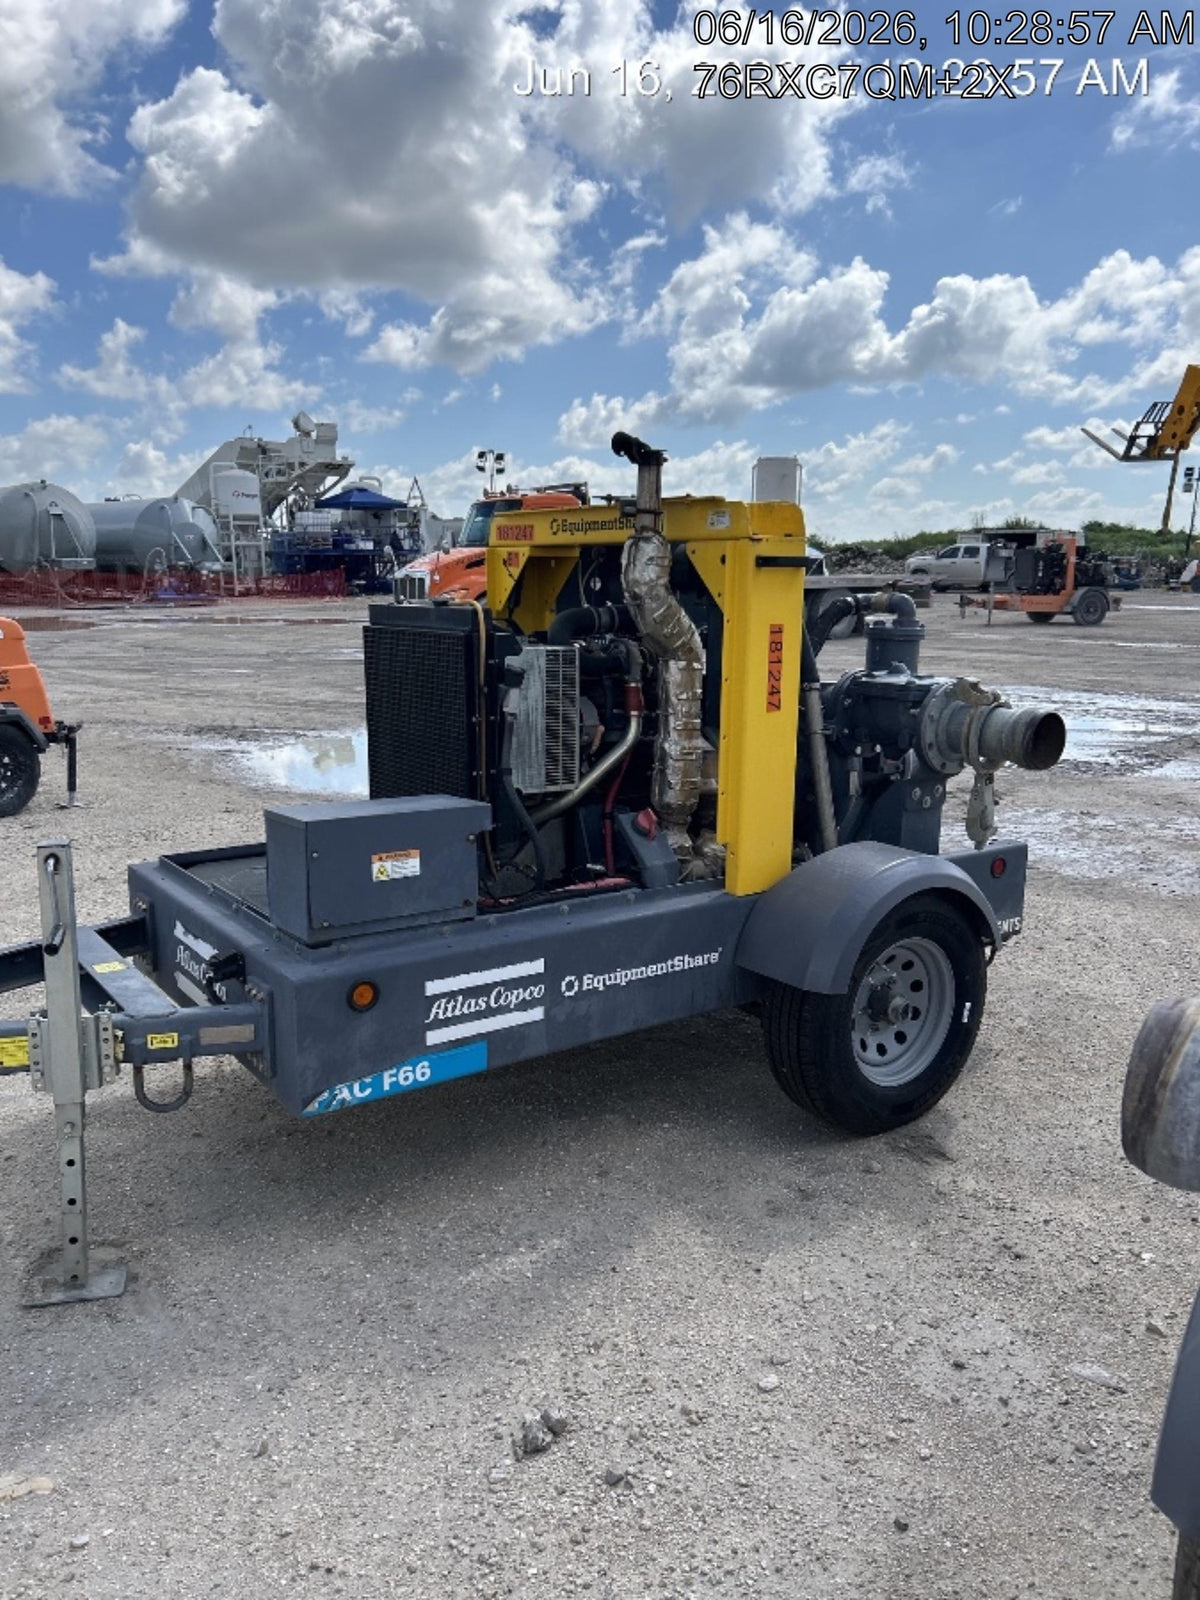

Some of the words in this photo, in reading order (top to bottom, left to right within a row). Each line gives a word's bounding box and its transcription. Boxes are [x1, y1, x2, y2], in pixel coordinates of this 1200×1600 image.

[497, 525, 534, 541] 181247
[561, 515, 664, 536] EquipmentSh
[768, 626, 783, 711] 181247
[582, 951, 719, 992] EquipmentShare
[425, 996, 486, 1023] Atlas
[490, 984, 545, 1009] Copco
[383, 1061, 431, 1091] F66
